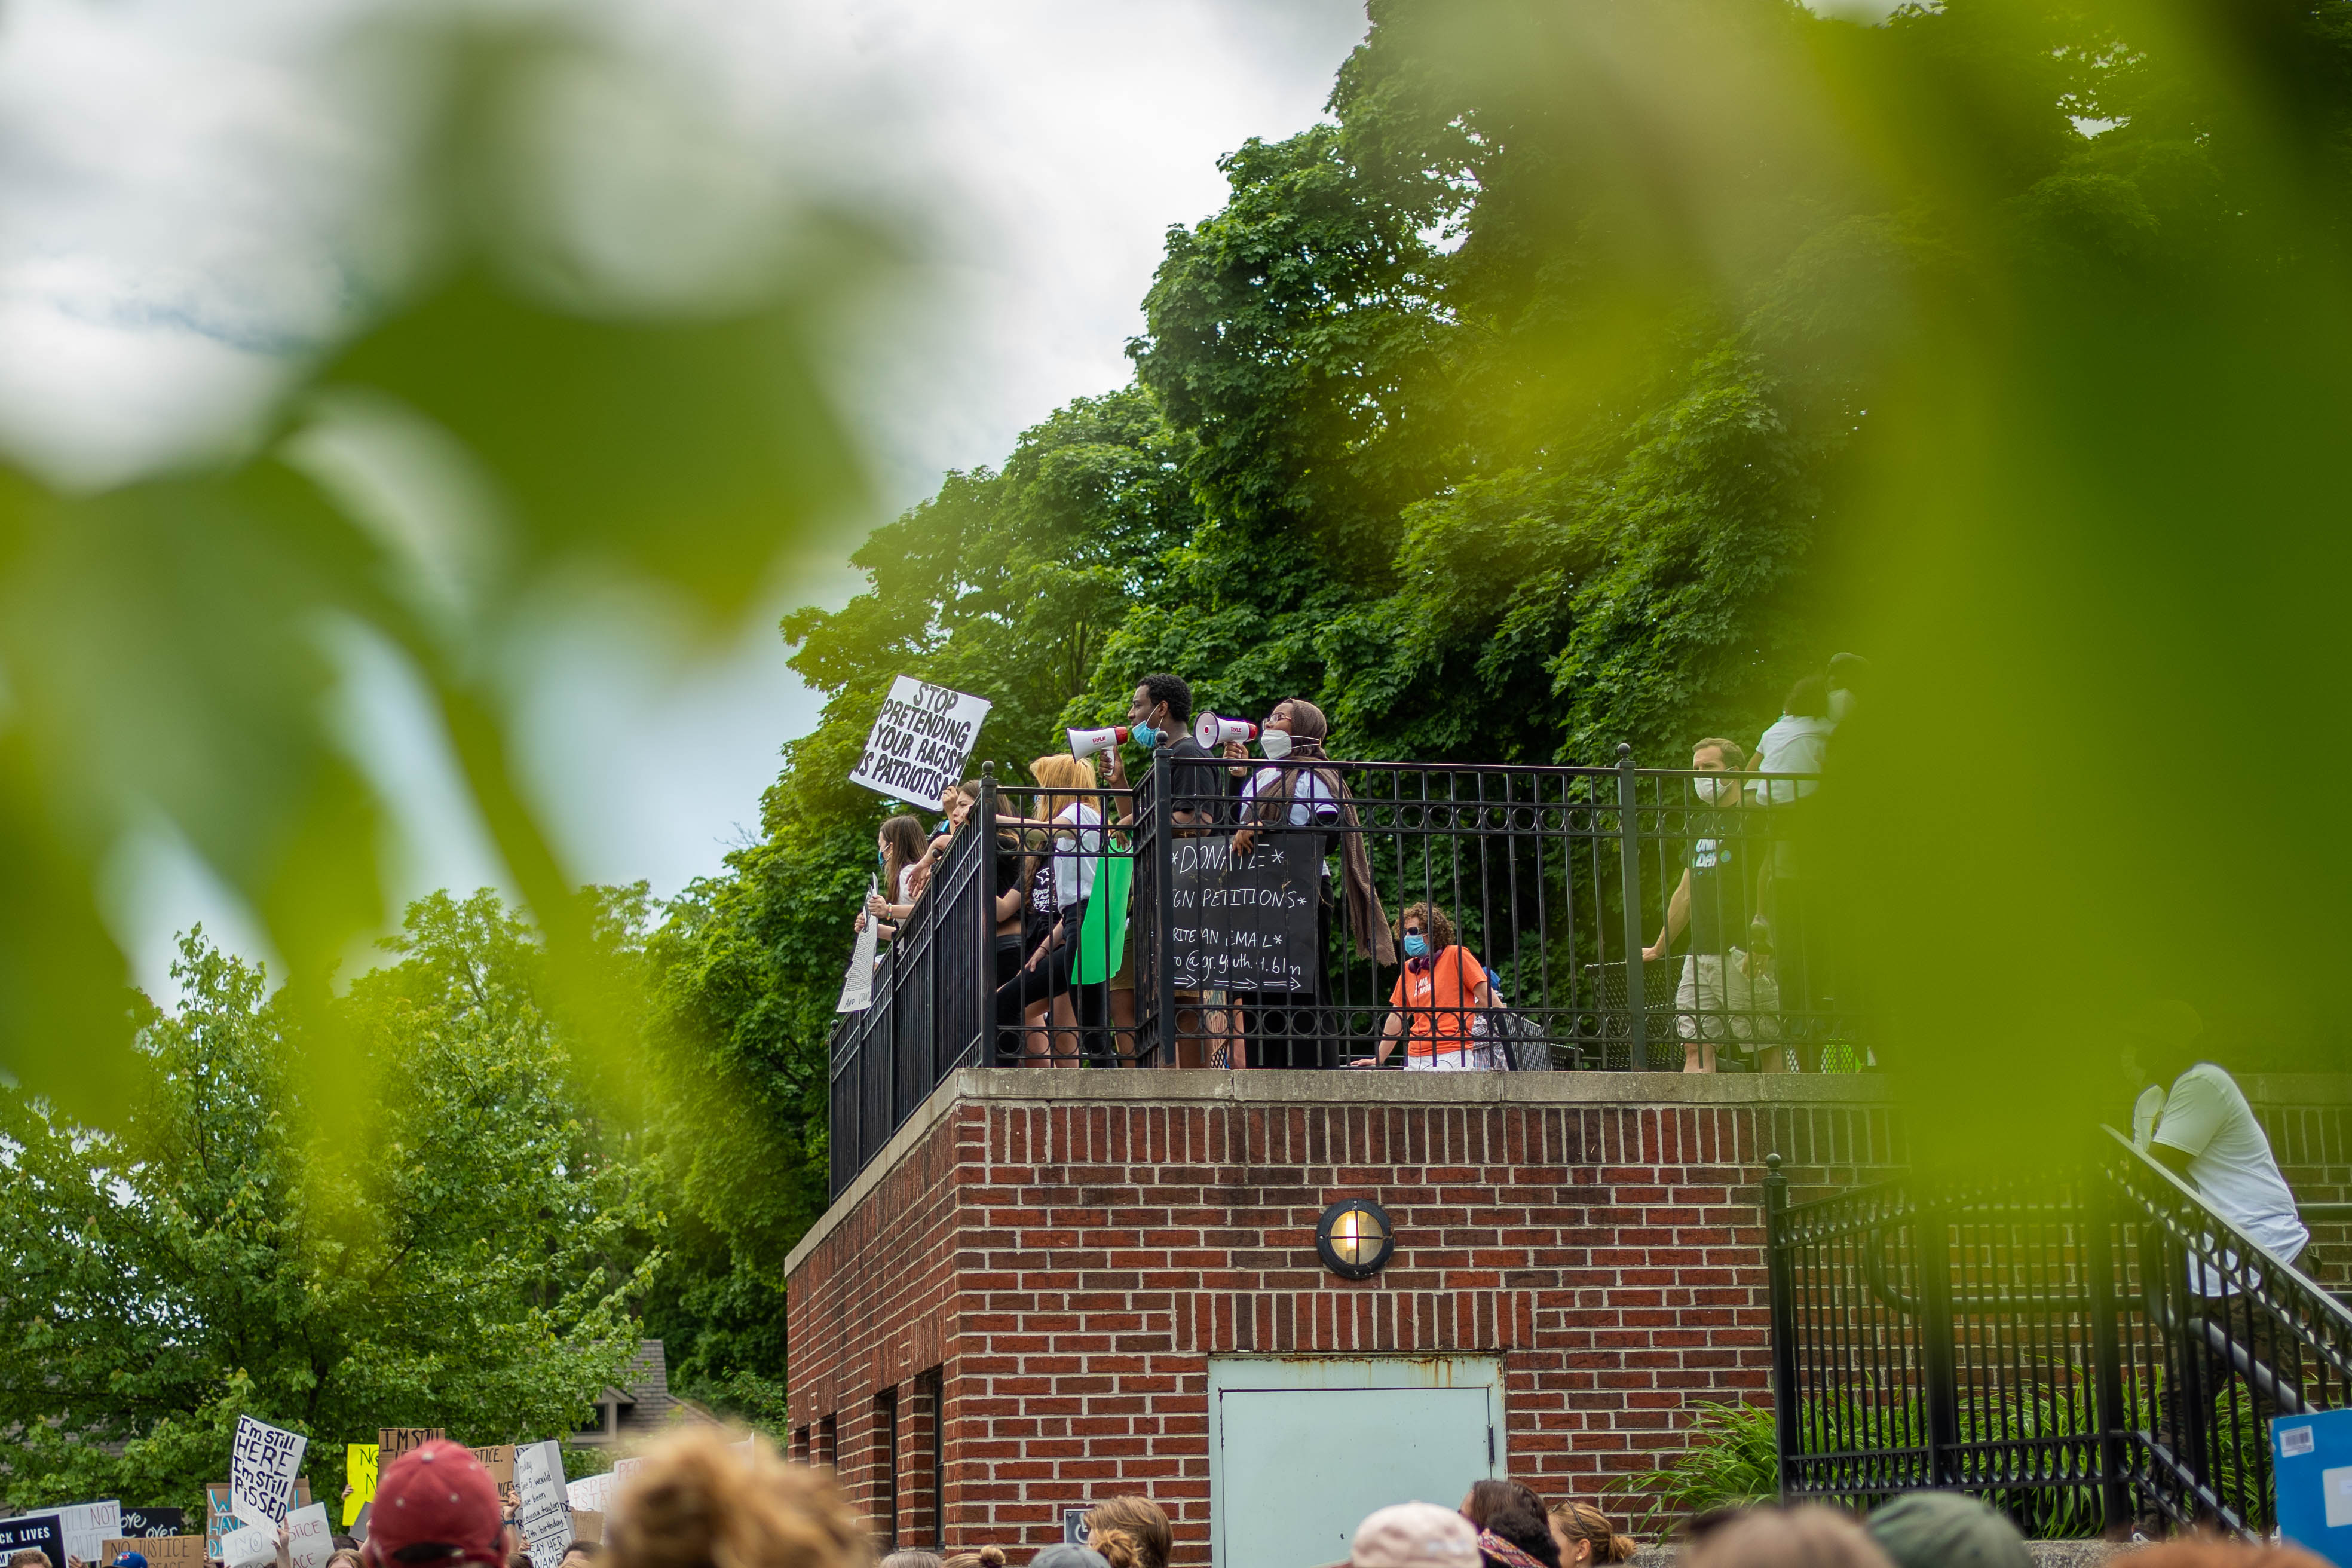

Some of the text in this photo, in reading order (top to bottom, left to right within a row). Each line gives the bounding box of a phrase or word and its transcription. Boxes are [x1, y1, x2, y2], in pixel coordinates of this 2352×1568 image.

[913, 682, 958, 716] STOP
[879, 698, 971, 751] PRETENDING
[875, 723, 970, 777] YOUR RACISM
[854, 749, 874, 776] IS
[1173, 927, 1196, 942] RITE
[1201, 928, 1219, 945] AN
[238, 1417, 262, 1441] I'm
[237, 1435, 295, 1478] HERE
[233, 1455, 254, 1483] I'm
[535, 1471, 552, 1486] would
[532, 1492, 546, 1503] been
[541, 1501, 560, 1515] taylors
[63, 1504, 117, 1533] ILL NOT
[121, 1512, 147, 1529] ove
[20, 1526, 51, 1542] LIVES
[146, 1524, 178, 1538] over
[111, 1541, 130, 1558] NO
[136, 1537, 191, 1558] JUSTICE
[529, 1536, 565, 1560] SAY HER
